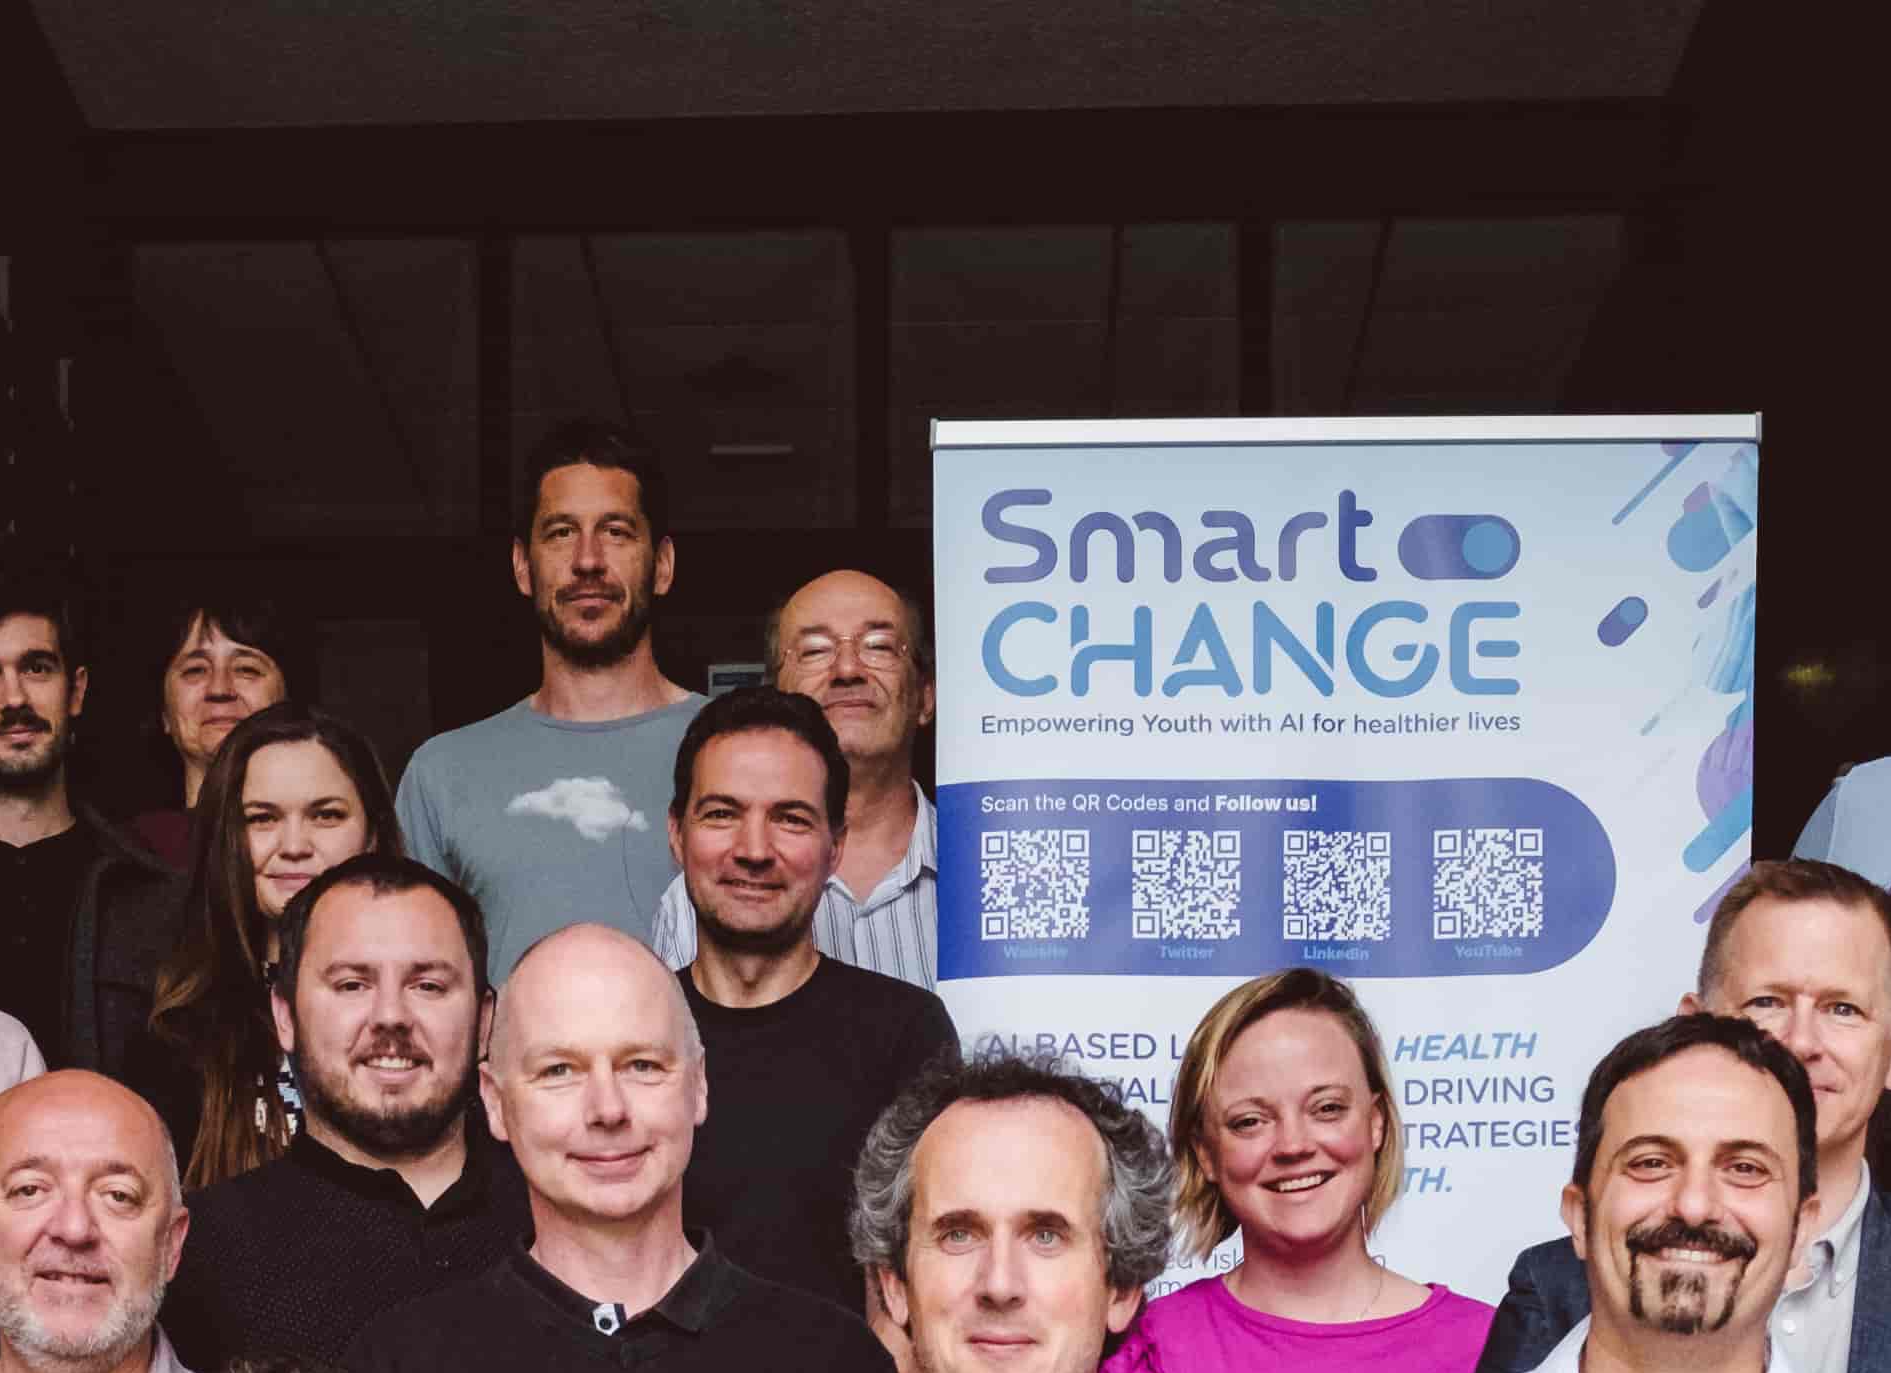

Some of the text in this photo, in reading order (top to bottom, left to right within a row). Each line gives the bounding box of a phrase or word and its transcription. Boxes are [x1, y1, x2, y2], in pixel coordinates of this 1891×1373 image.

[981, 489, 1378, 585] Smart
[981, 600, 1521, 698] CHANGE
[981, 711, 1521, 737] Empowering Youth with AI for healthier lives
[981, 793, 1317, 813] Scan the QR Codes and Follow us!
[1159, 945, 1214, 960] Twitter
[1454, 944, 1523, 959] YouTube
[1394, 1031, 1538, 1062] HEALTH
[1404, 1075, 1555, 1106] DRIVING
